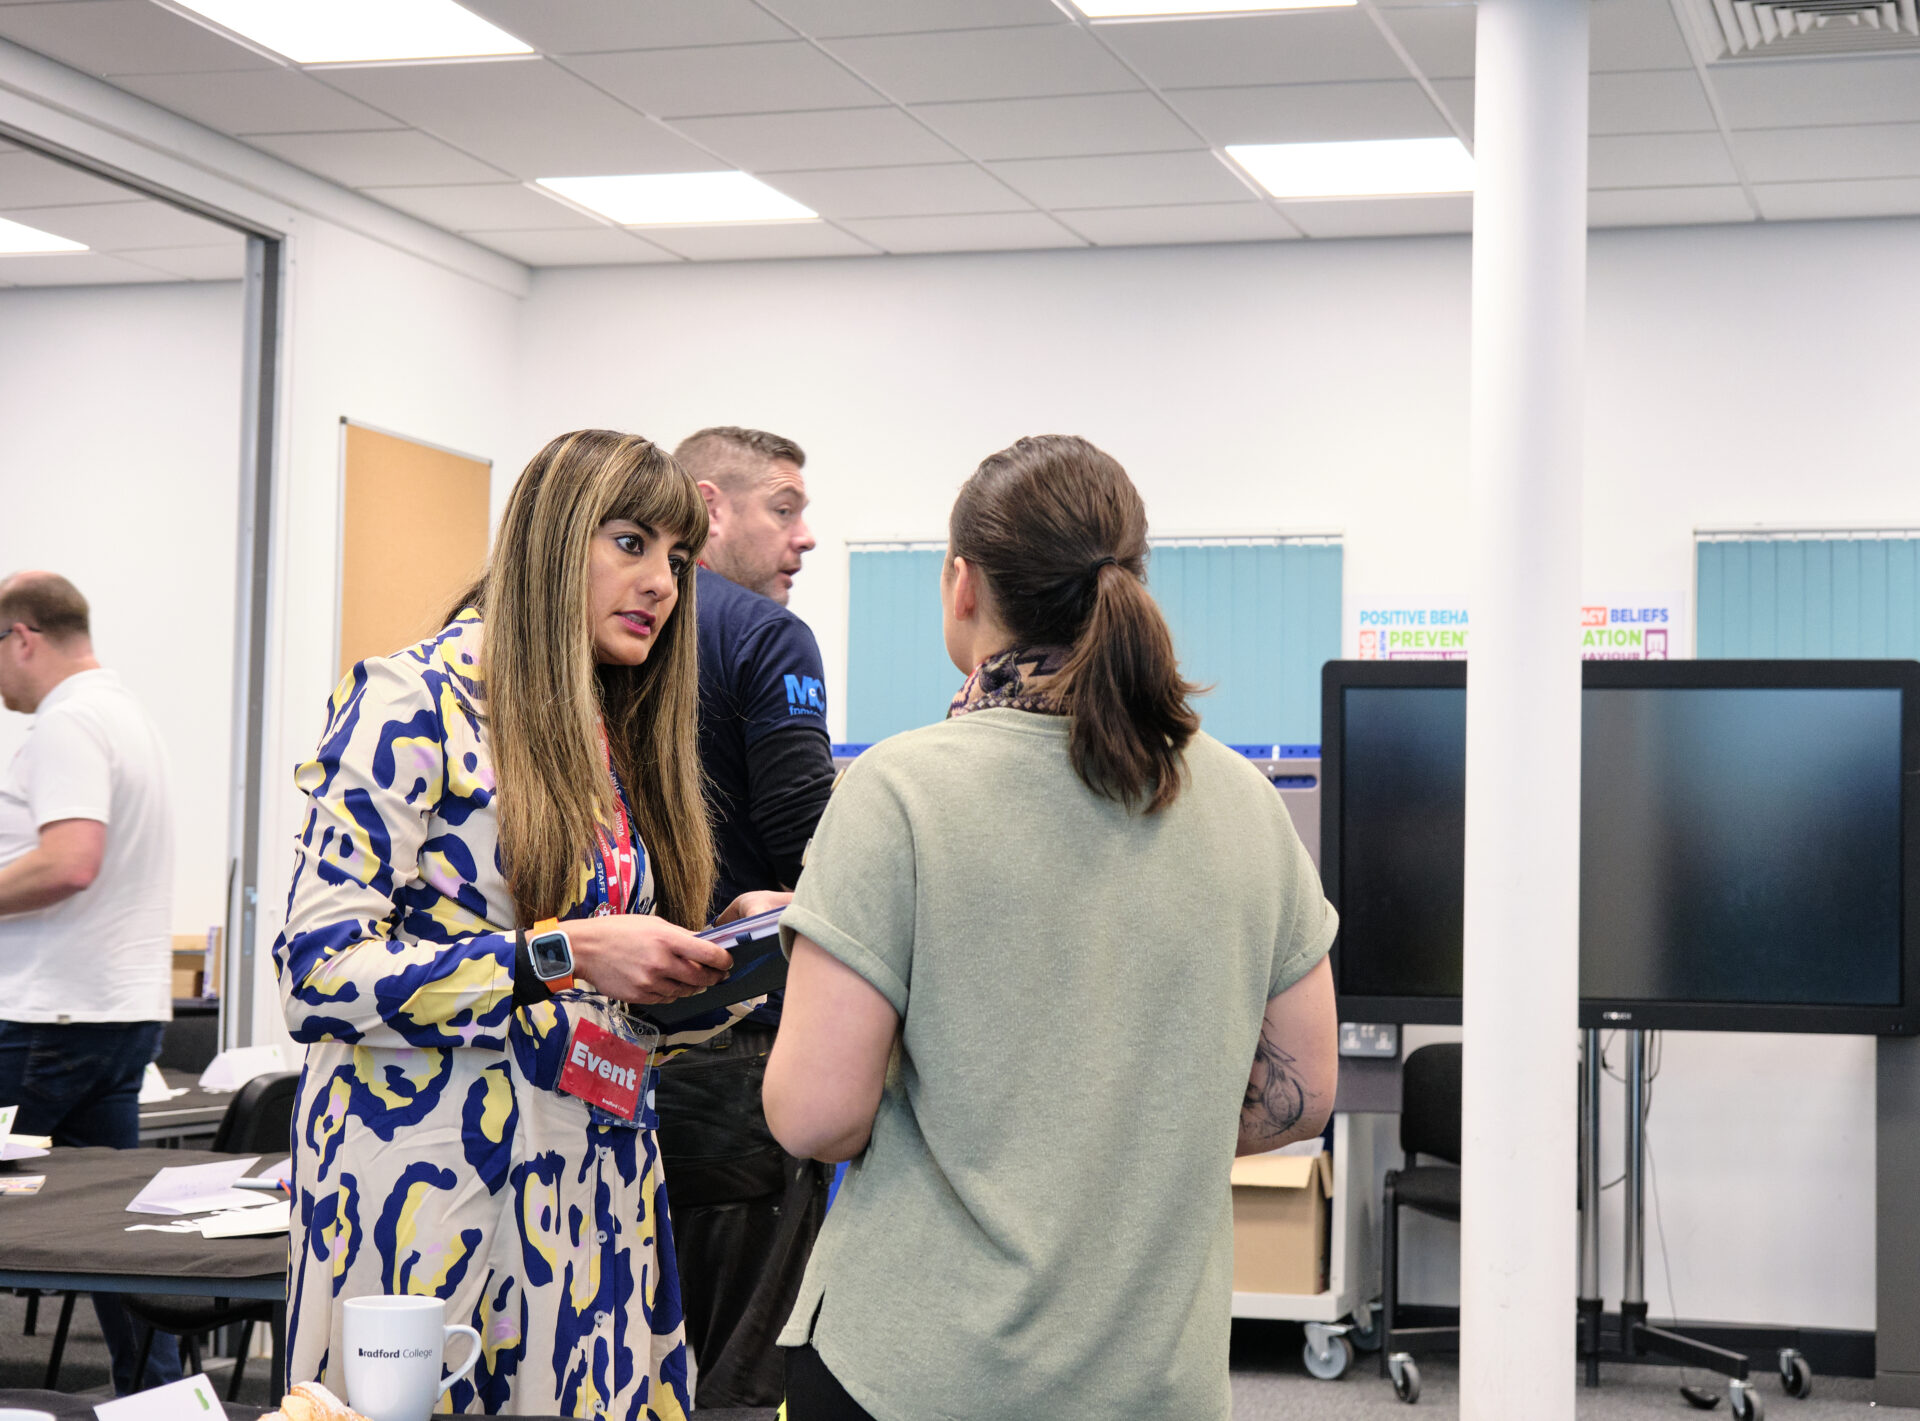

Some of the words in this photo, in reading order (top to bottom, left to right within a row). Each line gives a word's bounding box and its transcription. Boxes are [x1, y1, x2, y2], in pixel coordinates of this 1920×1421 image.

[1360, 610, 1425, 625] POSITIVE
[1430, 610, 1469, 625] BEHA
[1611, 608, 1669, 623] BELIEFS
[1390, 630, 1469, 648] PREVEN
[1582, 629, 1642, 647] ATION
[596, 862, 606, 895] STAFF
[571, 1040, 637, 1091] Event
[358, 1347, 400, 1359] Bradford
[402, 1348, 433, 1360] College
